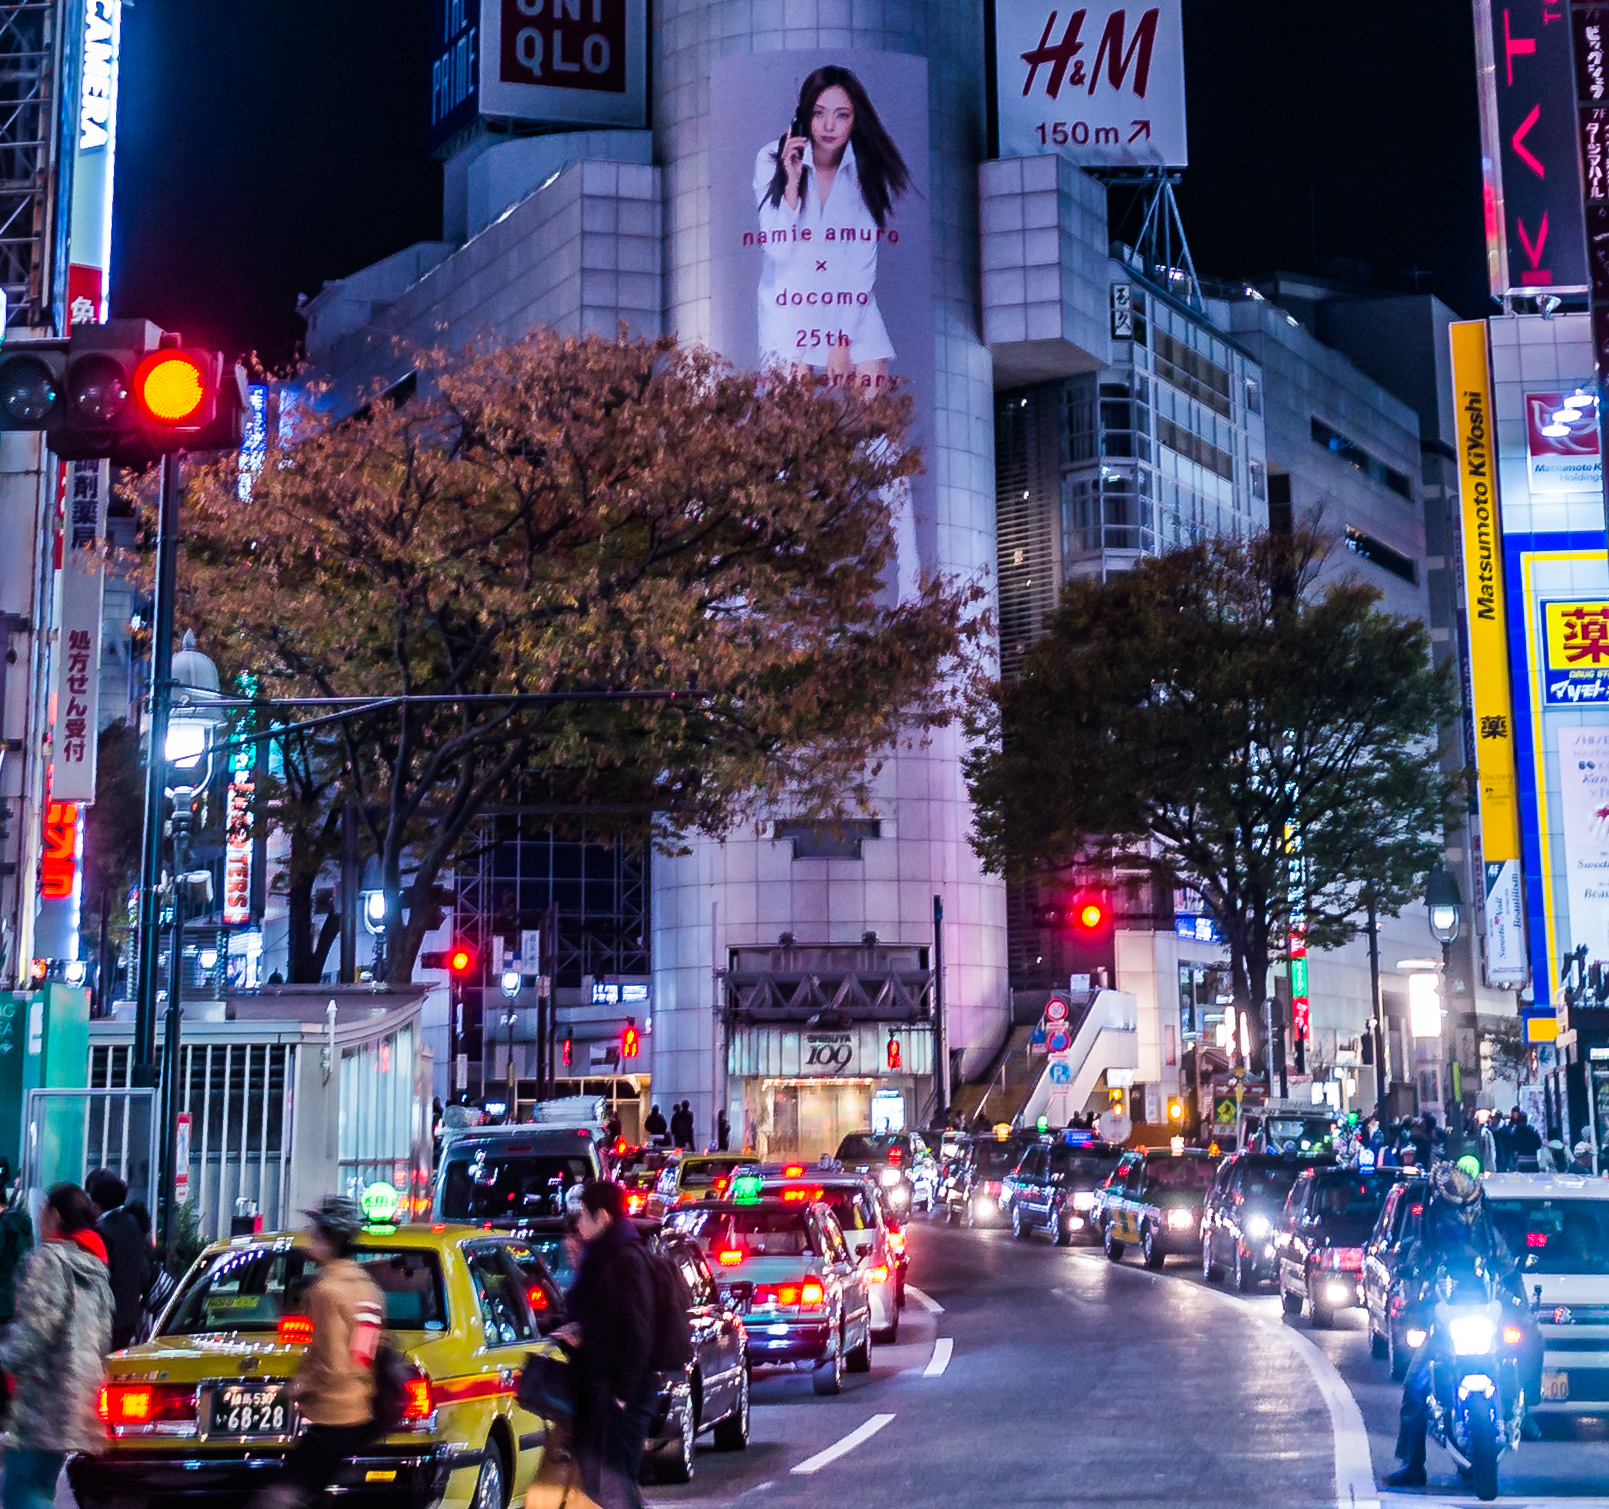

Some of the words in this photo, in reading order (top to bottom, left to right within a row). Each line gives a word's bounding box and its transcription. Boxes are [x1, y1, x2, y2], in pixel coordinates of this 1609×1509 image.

[515, 30, 612, 78] QLO
[1020, 7, 1160, 100] H&M
[431, 22, 478, 127] PRIME
[1035, 120, 1121, 146] 150m
[1586, 122, 1605, 198] タージマハール
[742, 225, 813, 247] namie
[824, 227, 900, 245] amuro
[775, 288, 869, 307] docomo
[796, 328, 851, 348] 25th
[1463, 391, 1489, 478] KiYoshi
[1534, 463, 1592, 474] Matsumoto
[1476, 482, 1496, 621] Matsumoto
[64, 630, 91, 762] 処方せん受付
[1480, 714, 1509, 740] 薬
[804, 1043, 853, 1070] 109
[227, 1405, 285, 1430] 68-28
